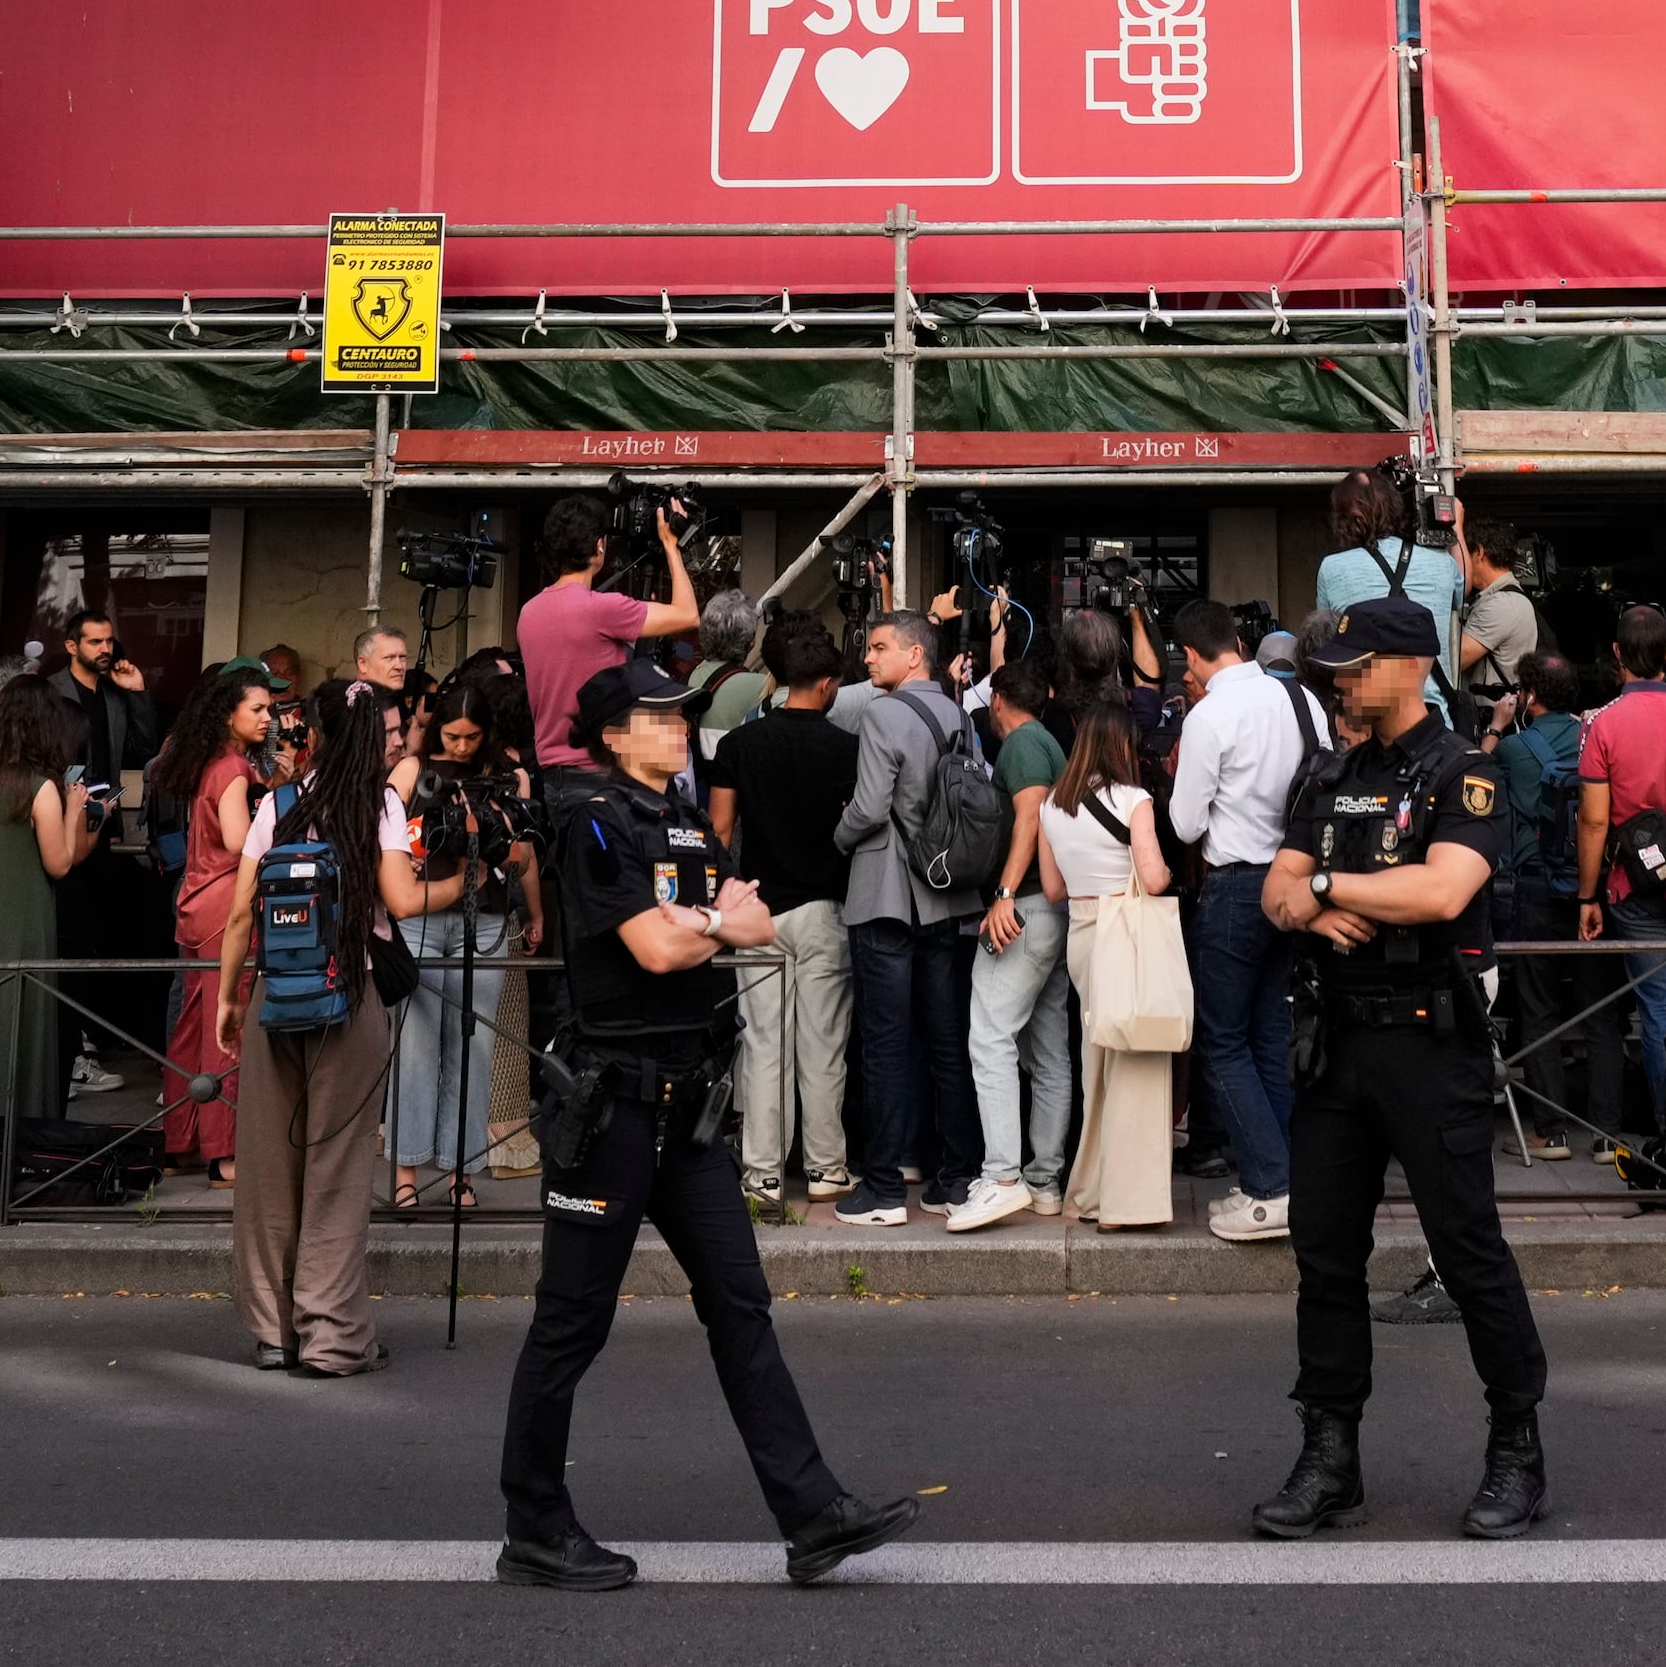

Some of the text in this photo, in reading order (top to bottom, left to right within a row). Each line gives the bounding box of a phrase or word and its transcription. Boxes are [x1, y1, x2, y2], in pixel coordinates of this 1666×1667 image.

[333, 221, 437, 231] ALARMA CONECTADA
[348, 260, 433, 270] 91 7853880
[341, 348, 418, 360] CENTAURO
[384, 361, 418, 369] SEGURIDAD
[582, 435, 665, 458] Layher
[1101, 436, 1185, 459] Layher
[1335, 796, 1378, 805] POLICIA
[1334, 804, 1386, 813] NACIONAL
[669, 837, 707, 849] NACIONAL
[273, 909, 308, 924] LiveU
[547, 1198, 605, 1215] NACIONAL
